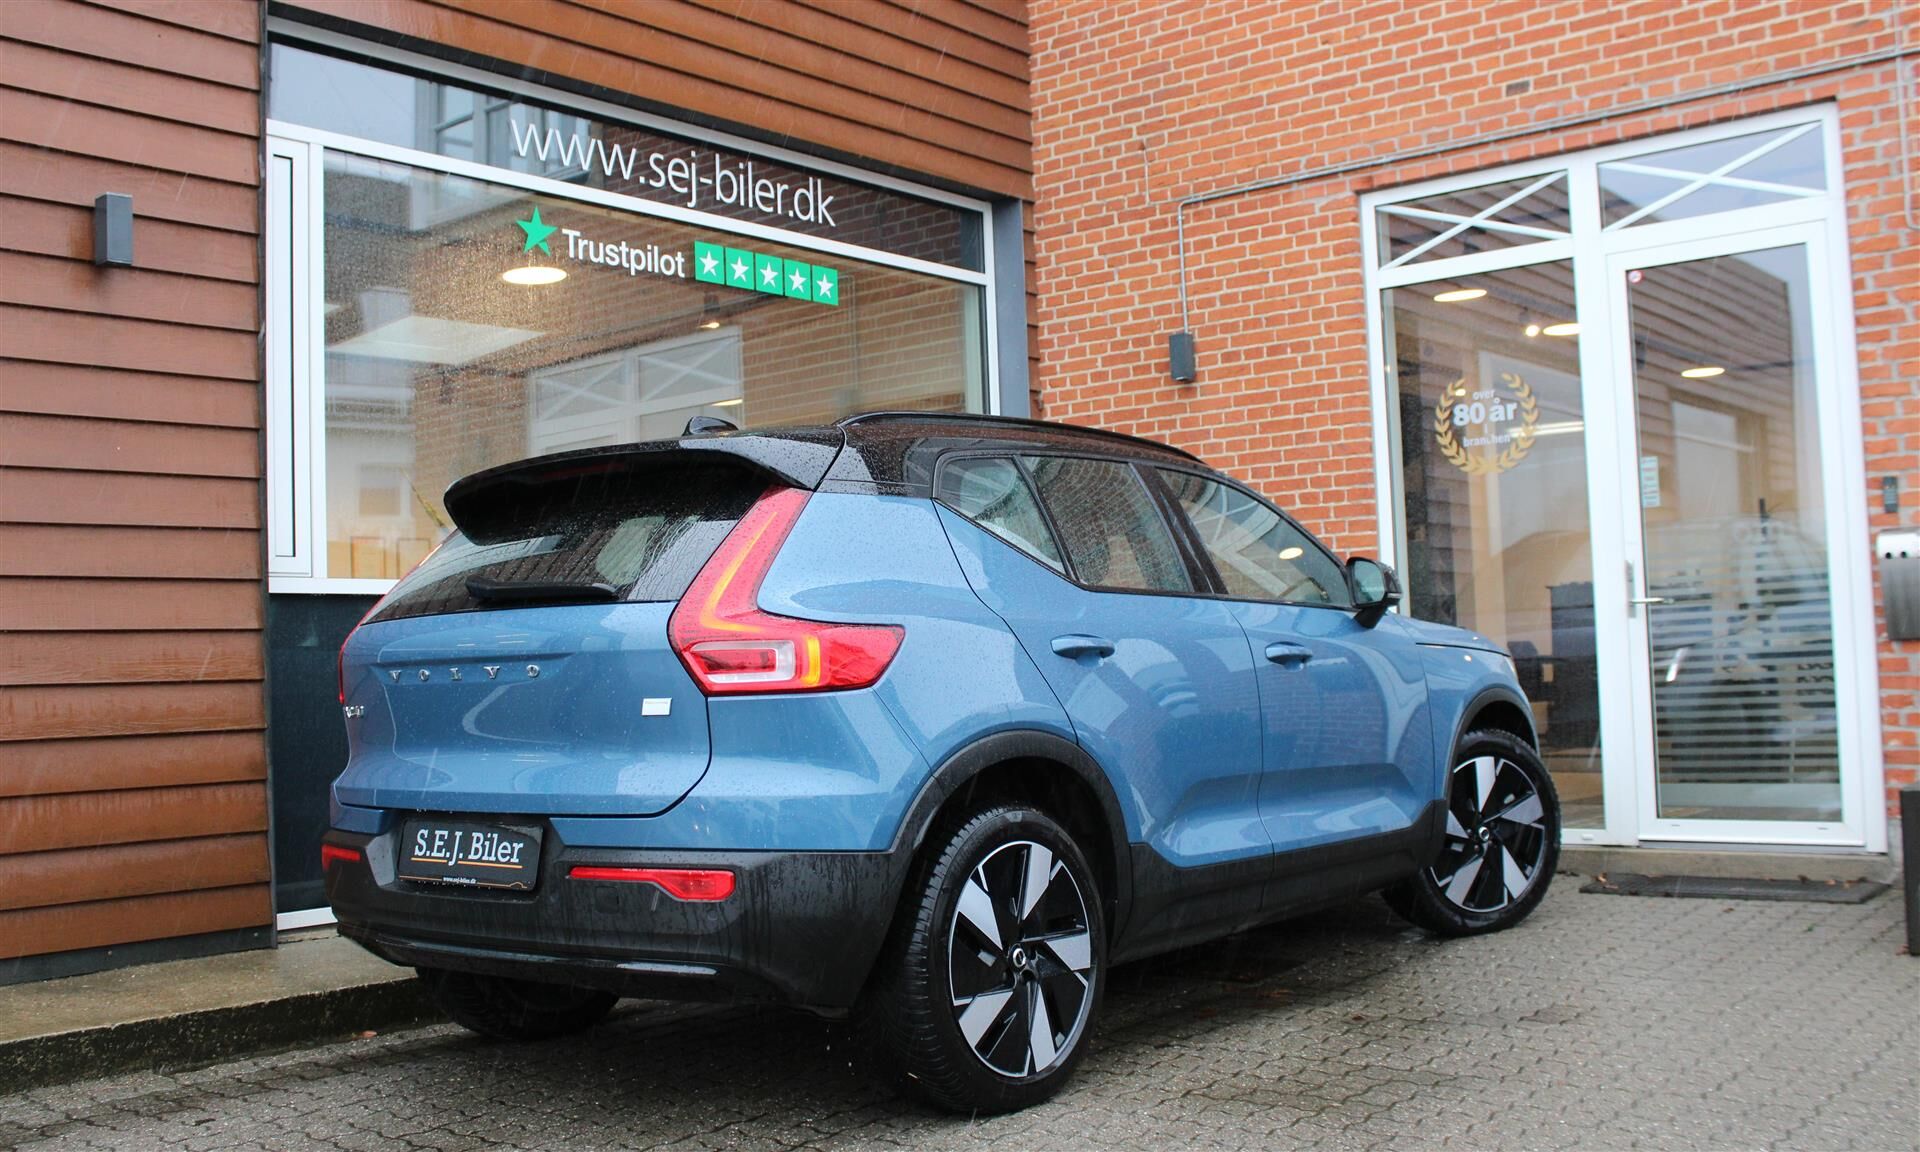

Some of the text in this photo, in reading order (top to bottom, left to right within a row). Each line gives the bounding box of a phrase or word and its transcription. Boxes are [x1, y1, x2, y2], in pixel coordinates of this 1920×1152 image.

[510, 119, 836, 227] www.sej-biler.dk
[561, 229, 685, 279] Trustpilot
[1453, 397, 1517, 426] 80 år
[1472, 389, 1496, 401] over
[389, 664, 540, 682] VOLVO
[414, 829, 524, 866] S.E.J. Biler
